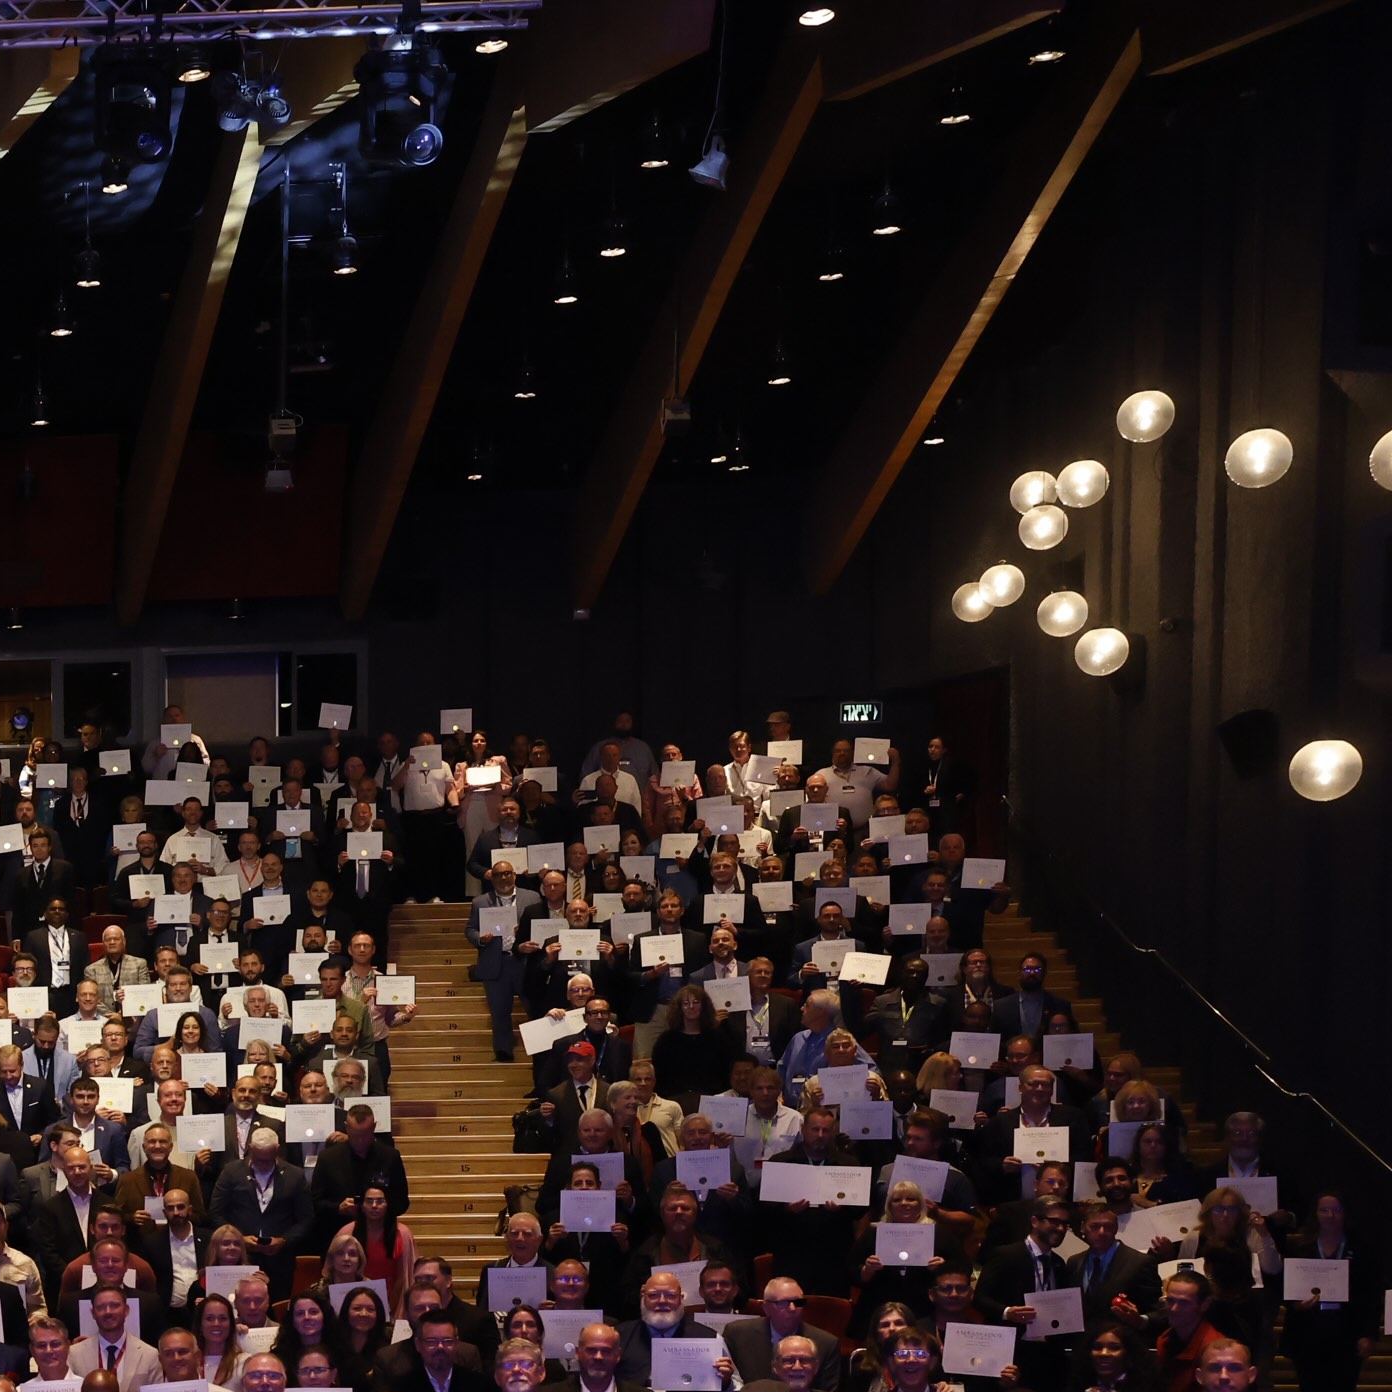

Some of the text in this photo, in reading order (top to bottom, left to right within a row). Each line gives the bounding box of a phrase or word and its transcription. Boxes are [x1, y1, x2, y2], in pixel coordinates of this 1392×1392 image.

[843, 704, 872, 721] יציאה
[454, 1090, 463, 1098] 17
[458, 1125, 468, 1133] 16
[460, 1164, 470, 1172] 15
[463, 1203, 474, 1212] 14
[467, 1245, 477, 1253] 13
